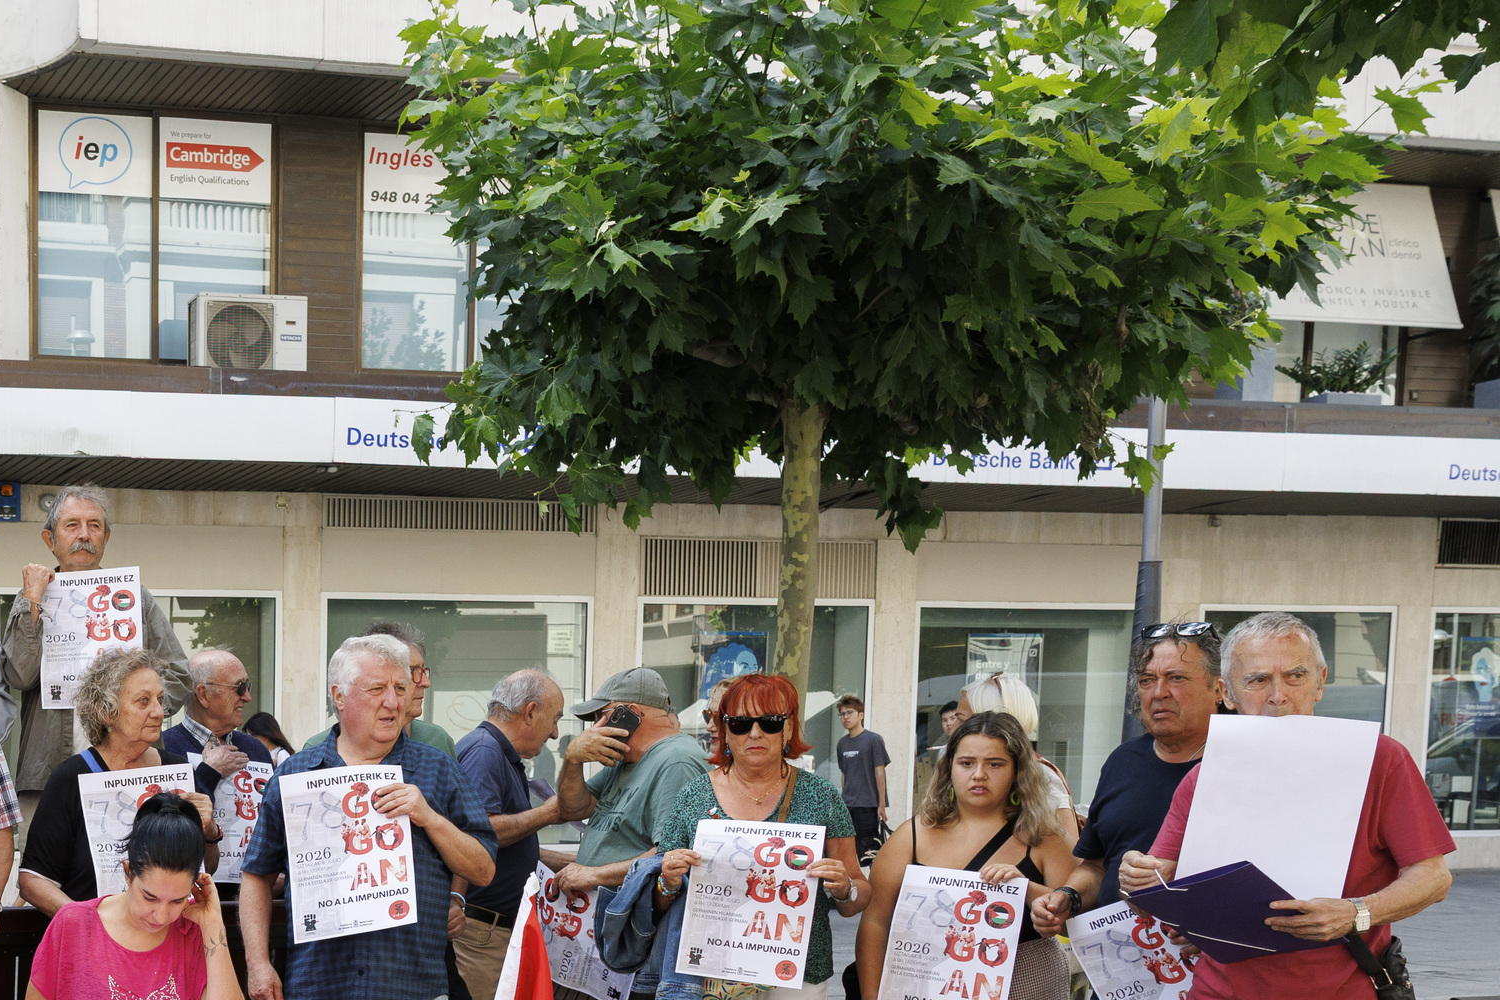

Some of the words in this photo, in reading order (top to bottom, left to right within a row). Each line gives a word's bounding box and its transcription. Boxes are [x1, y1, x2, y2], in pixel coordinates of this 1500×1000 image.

[181, 132, 202, 140] prepare
[75, 136, 118, 167] iep
[170, 147, 250, 168] Cambridge
[369, 146, 434, 170] Inglés
[170, 174, 196, 184] English
[371, 190, 397, 203] 948
[402, 192, 420, 203] 04
[1372, 287, 1431, 299] INVISIBLE
[1374, 300, 1419, 309] ADULTA
[933, 450, 1022, 469] Dtsche
[1449, 464, 1500, 481] Deuts
[60, 576, 121, 587] INPUNITATERIK
[46, 632, 75, 643] 2026
[975, 660, 1002, 669] Entre
[1004, 661, 1010, 670] y
[104, 774, 174, 788] INPUNITATERIK
[177, 772, 188, 781] EZ
[307, 773, 382, 789] INPUNITATERIK
[384, 771, 397, 779] EZ
[724, 825, 802, 839] INPUNITATERIK
[804, 832, 817, 840] EZ
[296, 846, 331, 863] 2026
[695, 881, 732, 897] 2026
[928, 876, 1004, 893] INPUNITATERIK
[1006, 886, 1019, 895] EZ
[318, 899, 333, 908] NO
[343, 896, 354, 904] LA
[356, 887, 408, 902] IMPUNIDAD
[707, 937, 723, 946] NO
[732, 941, 744, 949] LA
[745, 943, 800, 956] IMPUNIDAD
[895, 938, 931, 955] 2026
